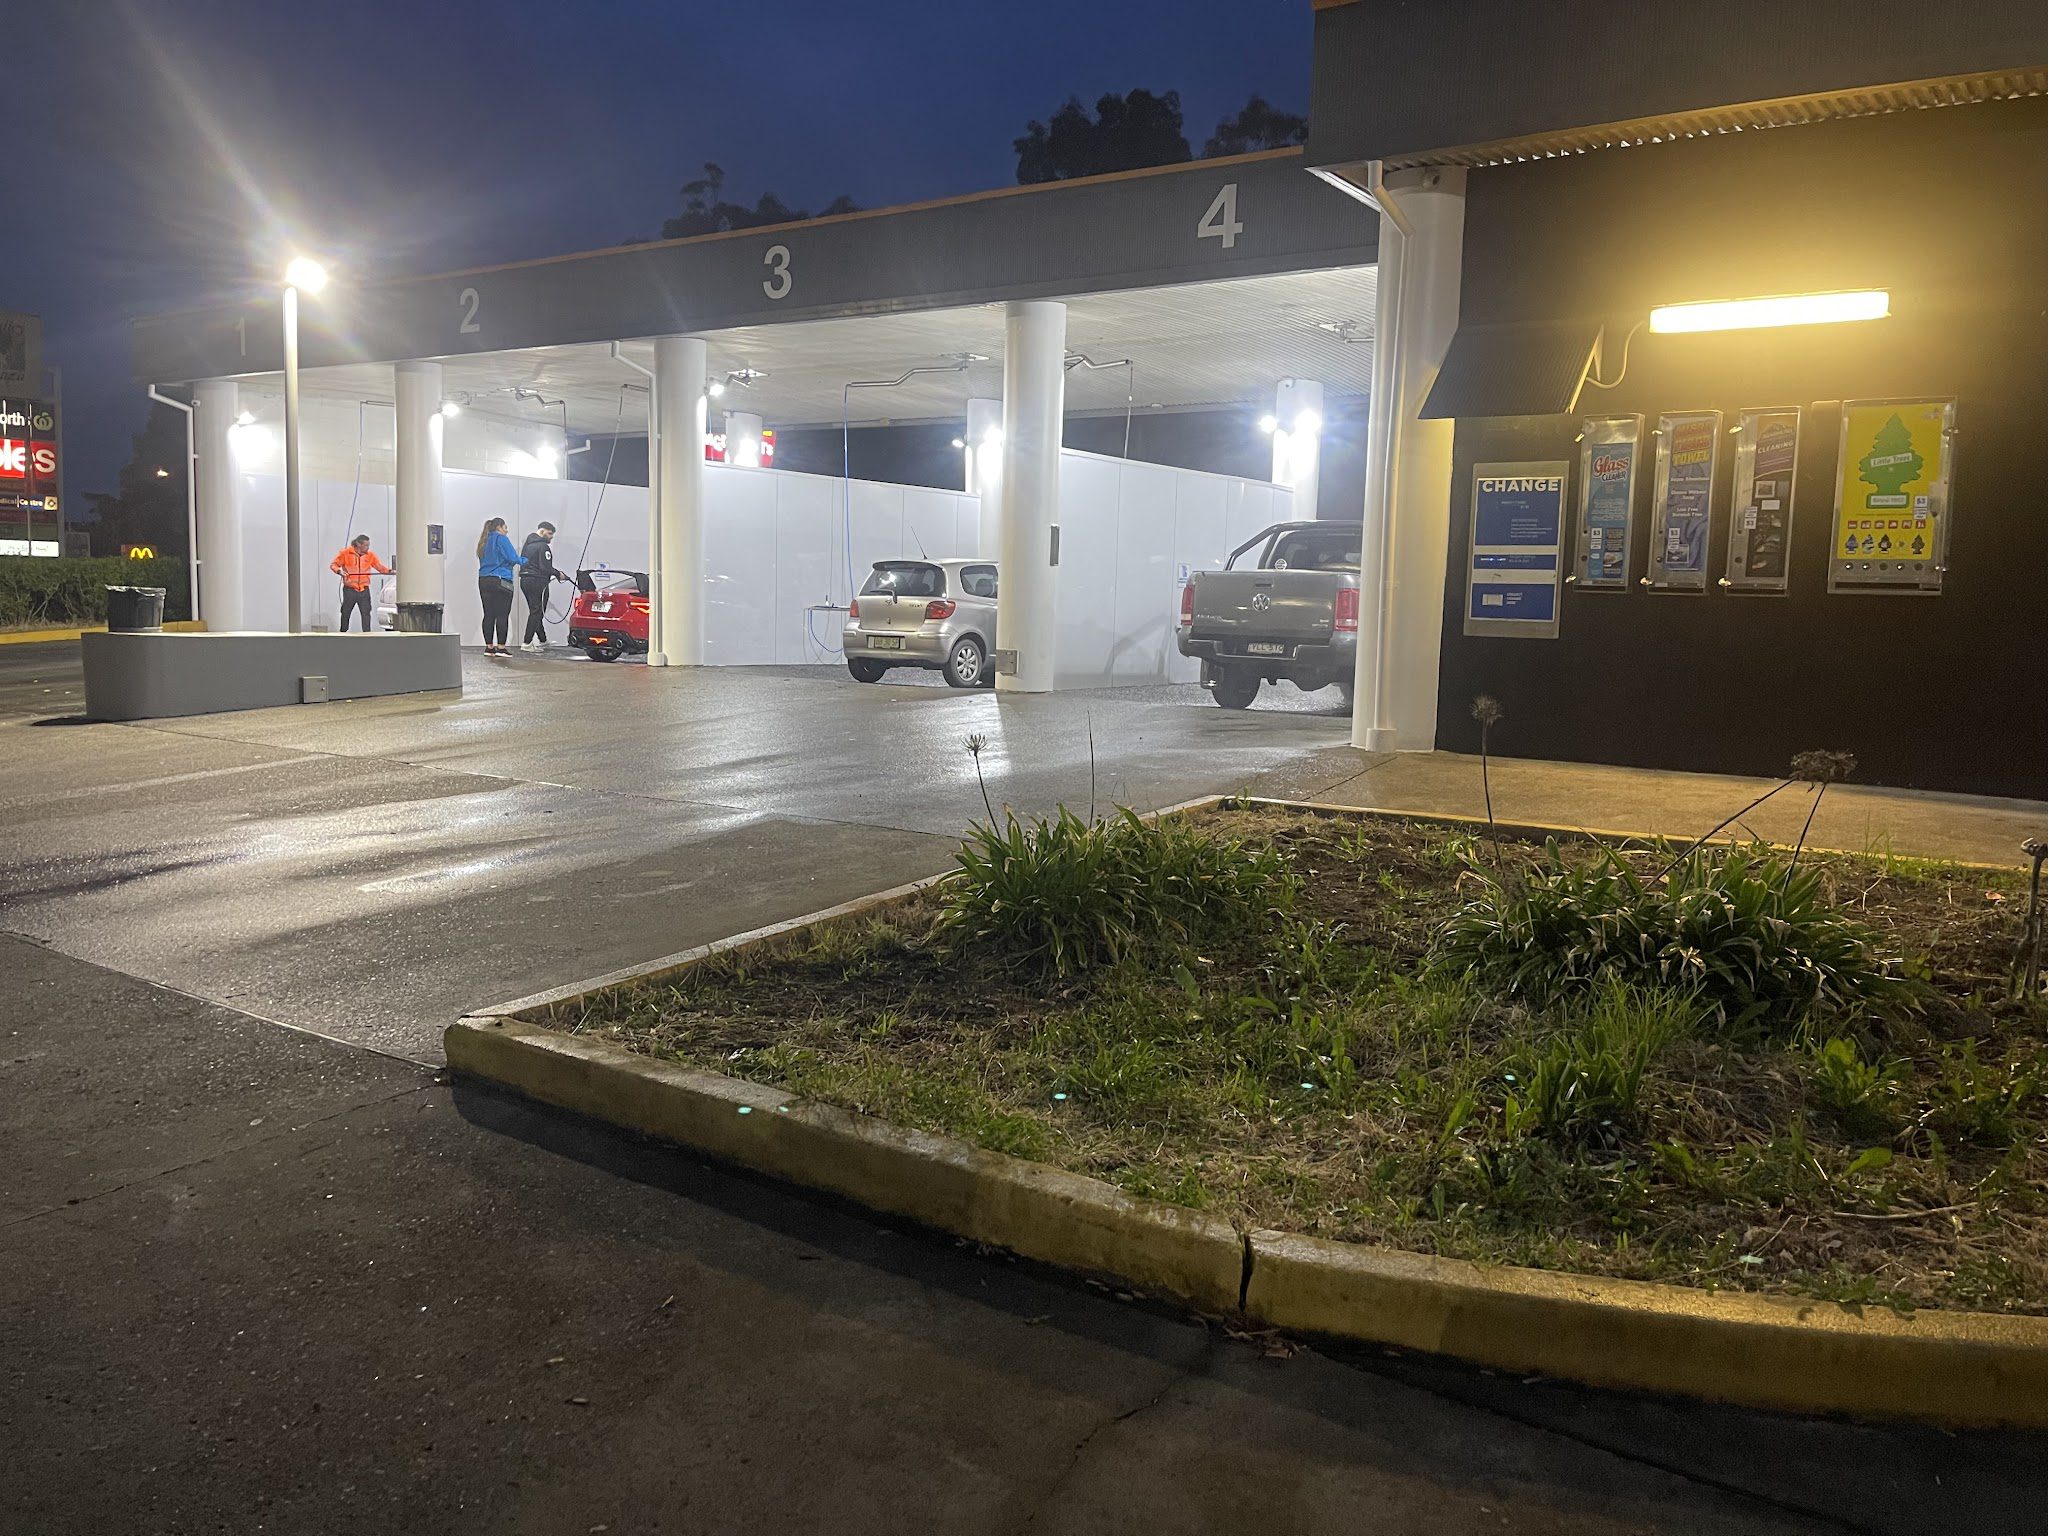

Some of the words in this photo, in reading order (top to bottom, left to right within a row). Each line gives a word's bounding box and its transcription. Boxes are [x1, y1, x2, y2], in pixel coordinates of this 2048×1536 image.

[1197, 183, 1244, 249] 4
[762, 244, 793, 300] 3
[459, 287, 480, 334] 2
[235, 316, 246, 356] 1
[0, 438, 56, 474] les
[1672, 449, 1710, 465] TOWEL
[1757, 439, 1794, 454] CLEANING
[1592, 455, 1630, 477] Glass
[1872, 457, 1891, 466] Little
[1482, 479, 1559, 493] CHANGE
[1601, 470, 1627, 482] CLEANER
